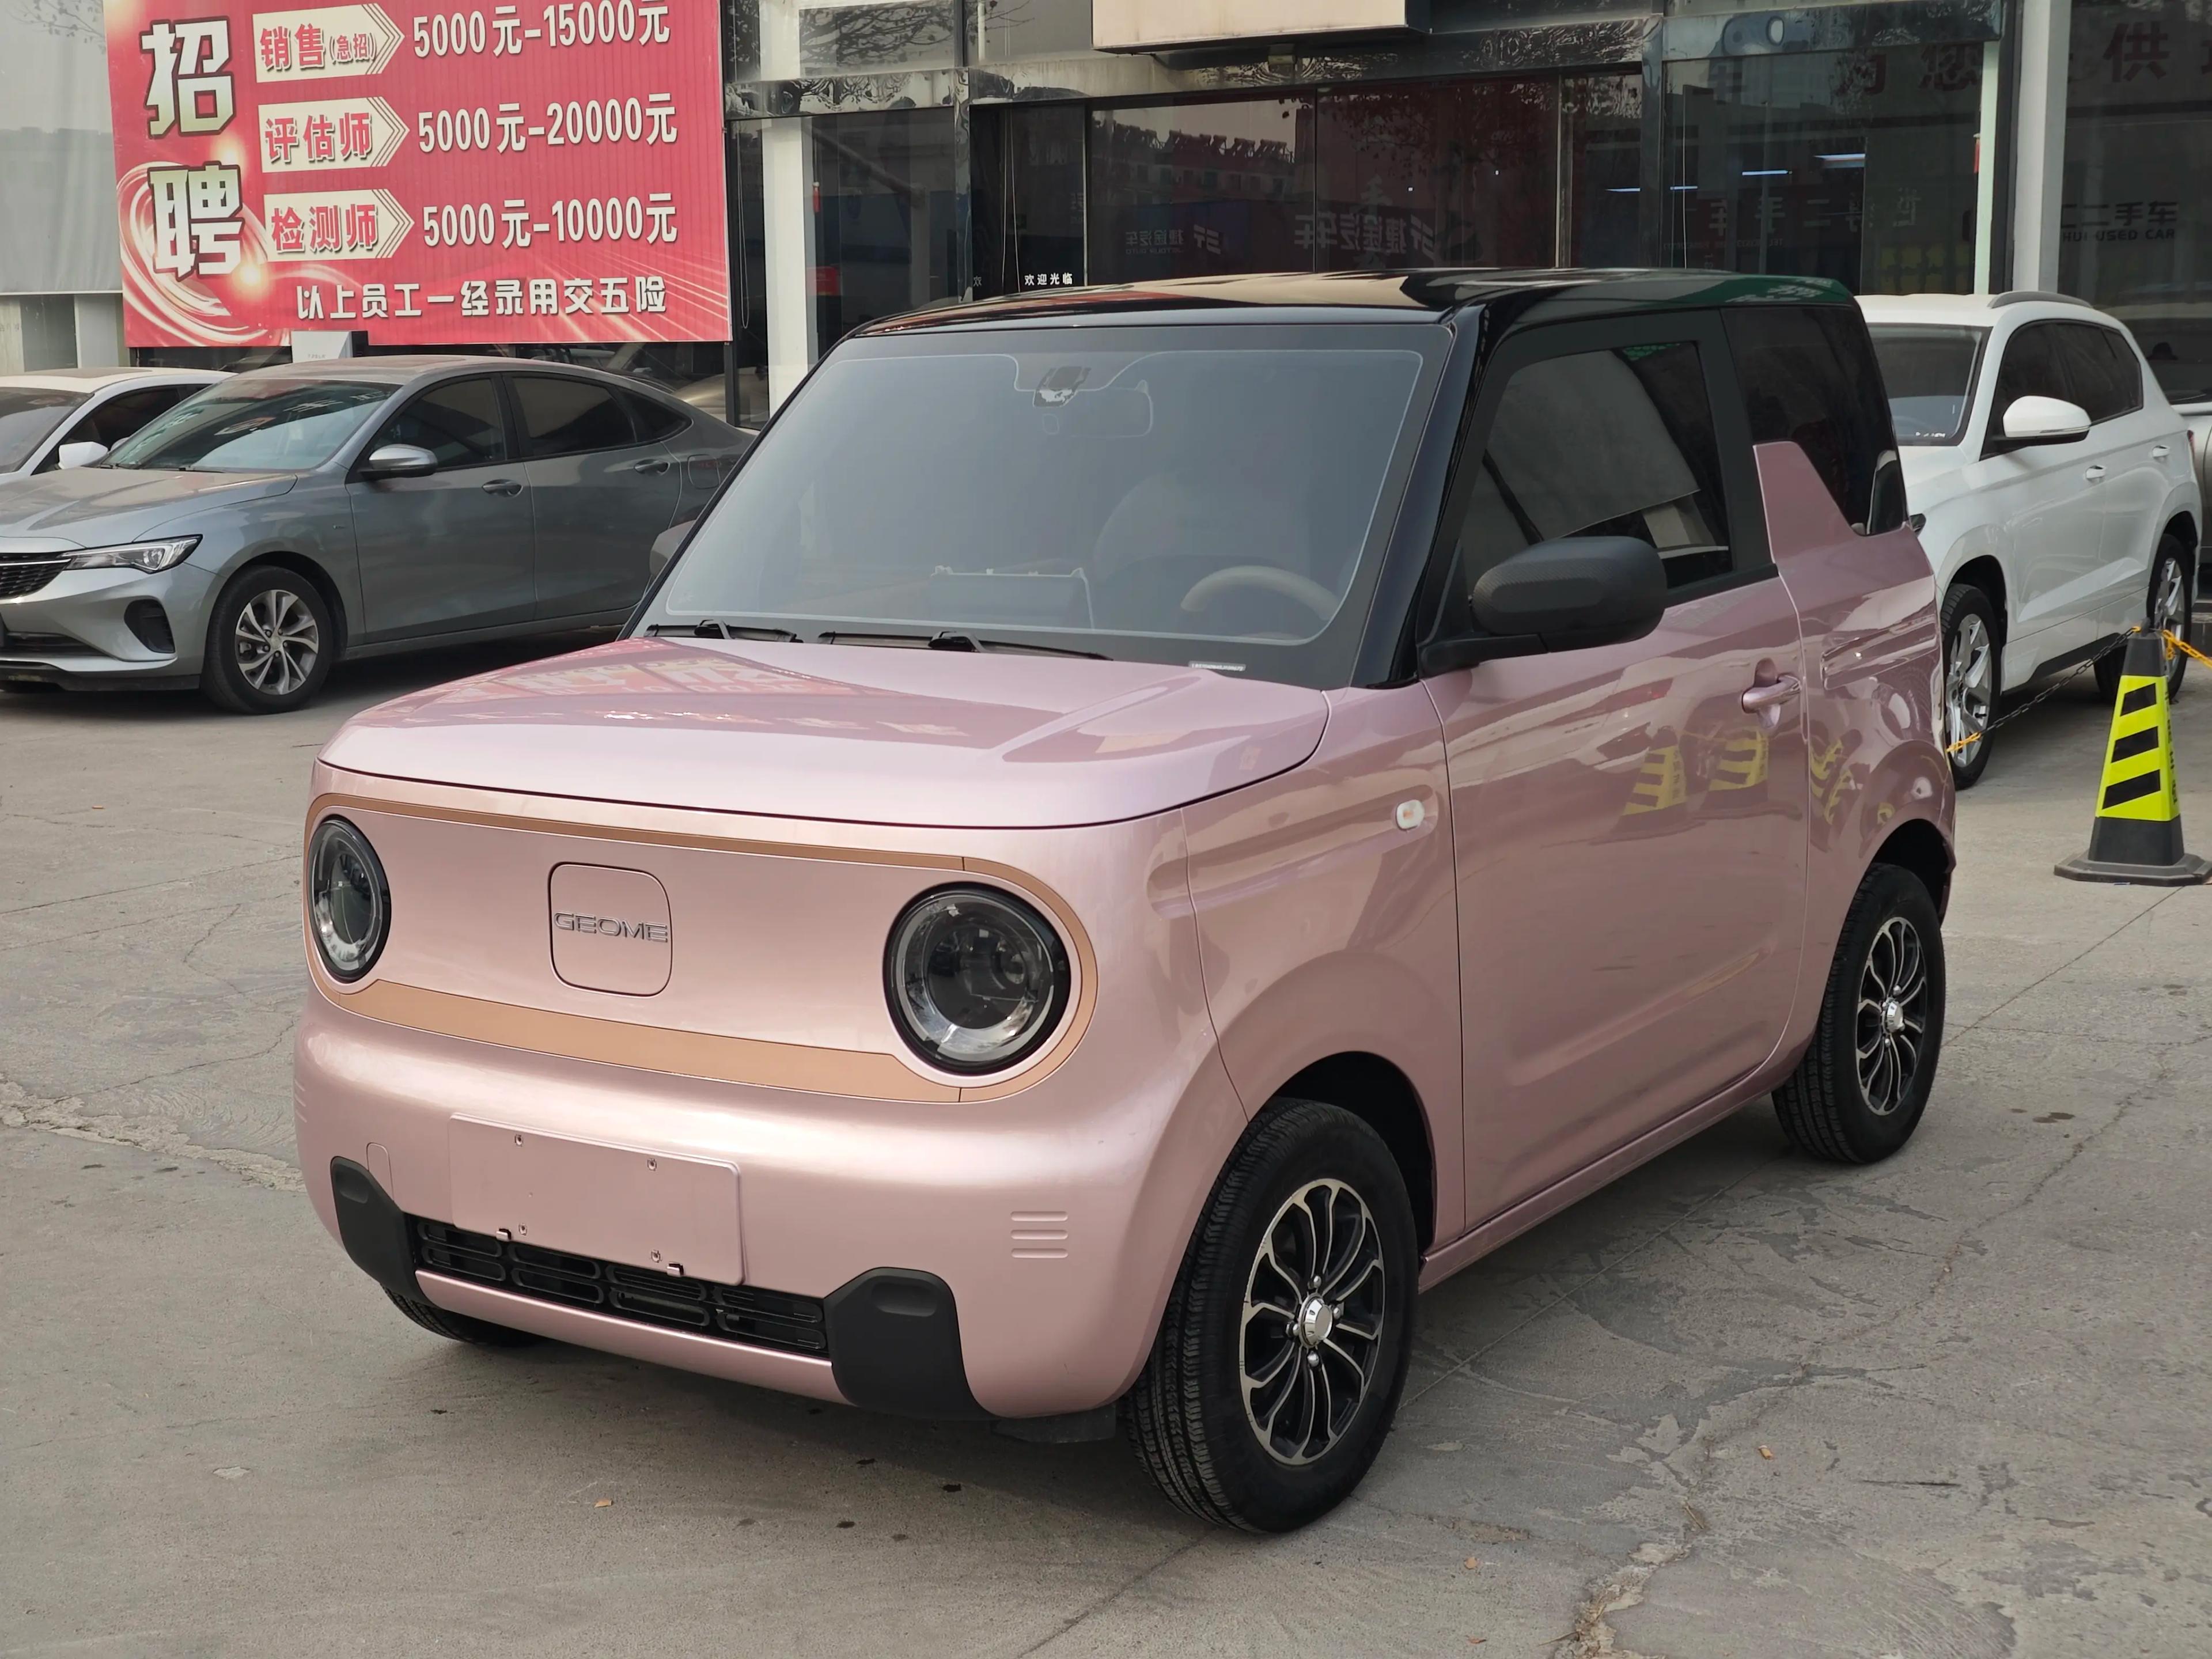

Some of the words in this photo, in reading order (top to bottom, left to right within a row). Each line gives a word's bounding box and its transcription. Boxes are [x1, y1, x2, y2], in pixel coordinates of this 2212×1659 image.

[412, 0, 671, 59] 5000元-15000元
[141, 16, 244, 281] 招聘
[264, 111, 376, 164] 评估师
[418, 92, 679, 155] 5000元-20000元
[270, 202, 379, 253] 检测师
[423, 192, 679, 251] 5000元-10000元
[2095, 230, 2138, 241] USED
[2145, 228, 2175, 240] CAR
[296, 275, 666, 321] 以上员工一经录用交五险
[1024, 272, 1073, 286] 欢迎光临
[554, 911, 668, 943] GEOME
